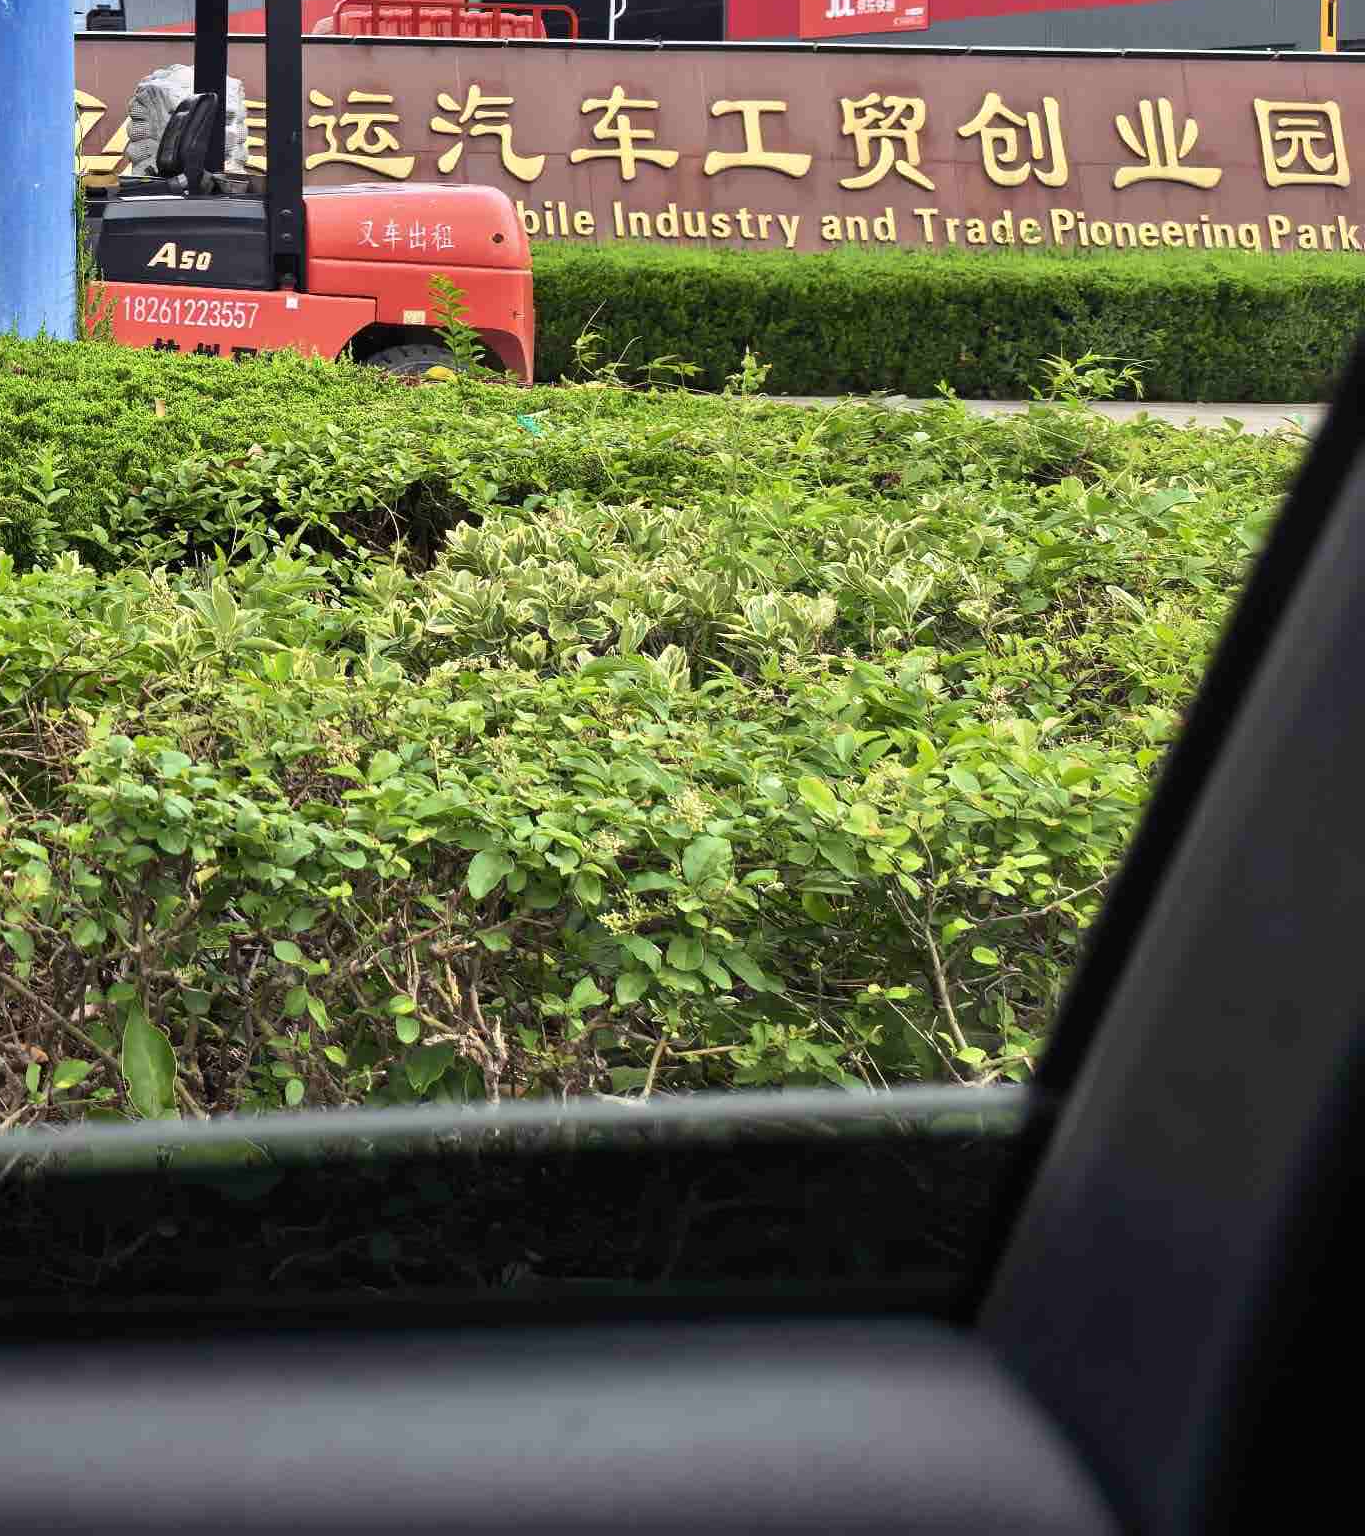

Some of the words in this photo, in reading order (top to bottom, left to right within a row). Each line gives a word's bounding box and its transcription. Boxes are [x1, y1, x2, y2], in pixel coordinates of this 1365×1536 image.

[75, 82, 1351, 193] 运汽车工贸创业园
[356, 219, 455, 251] 叉车出租
[612, 200, 800, 249] Industry
[820, 206, 896, 243] and
[914, 207, 1043, 245] Trade
[1049, 208, 1262, 253] Pioneering
[1268, 214, 1360, 251] Park
[123, 295, 260, 329] 18261223557
